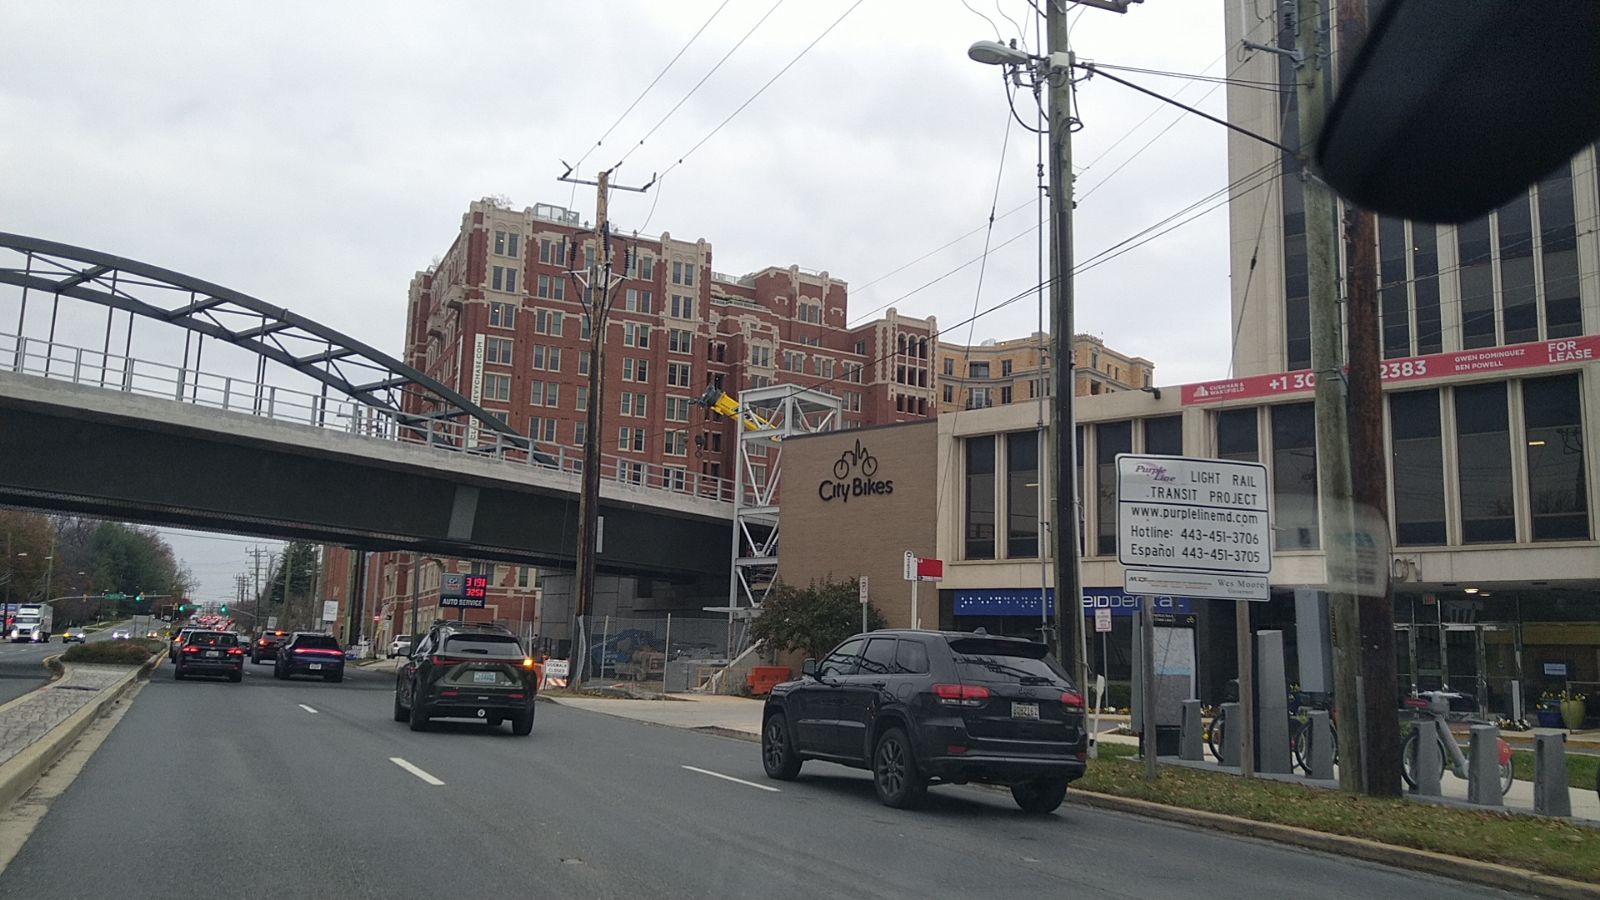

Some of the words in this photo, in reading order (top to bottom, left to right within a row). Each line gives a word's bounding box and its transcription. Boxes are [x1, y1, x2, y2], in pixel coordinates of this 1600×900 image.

[1548, 341, 1577, 353] FOR
[1454, 354, 1478, 363] GWEN
[1479, 349, 1526, 360] DOMINGUEZ
[1548, 349, 1592, 363] LEASE
[1472, 361, 1504, 370] POWELL
[1269, 376, 1288, 390] +1
[1380, 360, 1427, 379] 2383
[1209, 382, 1239, 391] CUSHMAN
[1209, 387, 1245, 395] WAKEFIELD
[1135, 464, 1167, 476] Purple
[1153, 471, 1177, 482] Line
[1190, 470, 1221, 485] LIGHT
[1232, 474, 1257, 488] RAIL
[818, 480, 851, 503] City
[852, 477, 894, 497] Bikes
[1151, 486, 1198, 501] TRANSIT
[1209, 490, 1258, 506] PROJECT
[1131, 507, 1259, 525] www.purplelinemd.com
[1130, 525, 1174, 539] Hotline:
[1180, 528, 1260, 545] 443-451-3706
[1130, 543, 1175, 558] Español
[1182, 545, 1261, 563] 443-451-3705
[1217, 579, 1235, 587] Wes
[1237, 580, 1265, 589] Moore
[458, 599, 483, 607] SERVICE
